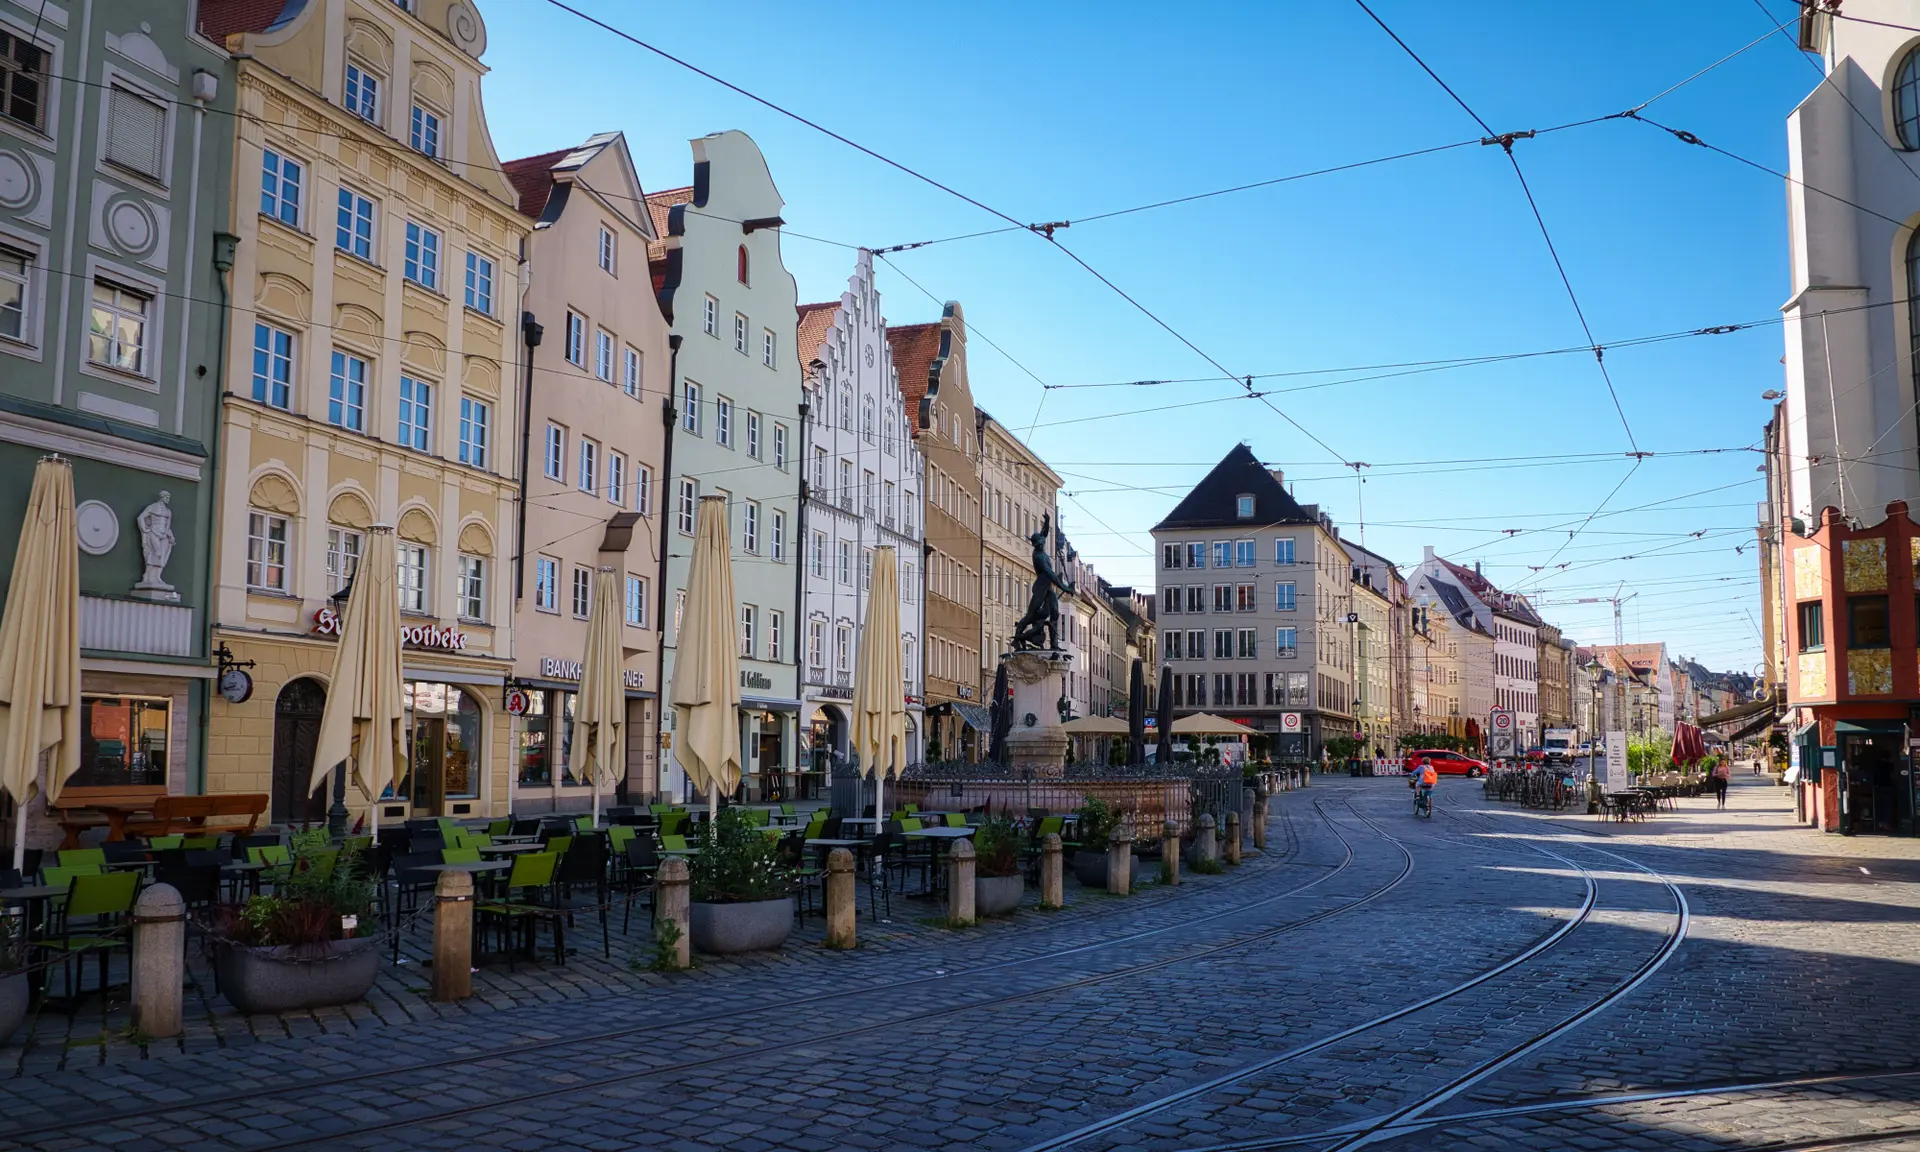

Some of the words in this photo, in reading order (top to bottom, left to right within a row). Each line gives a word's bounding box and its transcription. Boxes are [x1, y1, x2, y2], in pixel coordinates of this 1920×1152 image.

[400, 624, 467, 649] potheke
[546, 658, 582, 680] BANKH
[1498, 717, 1507, 725] 20
